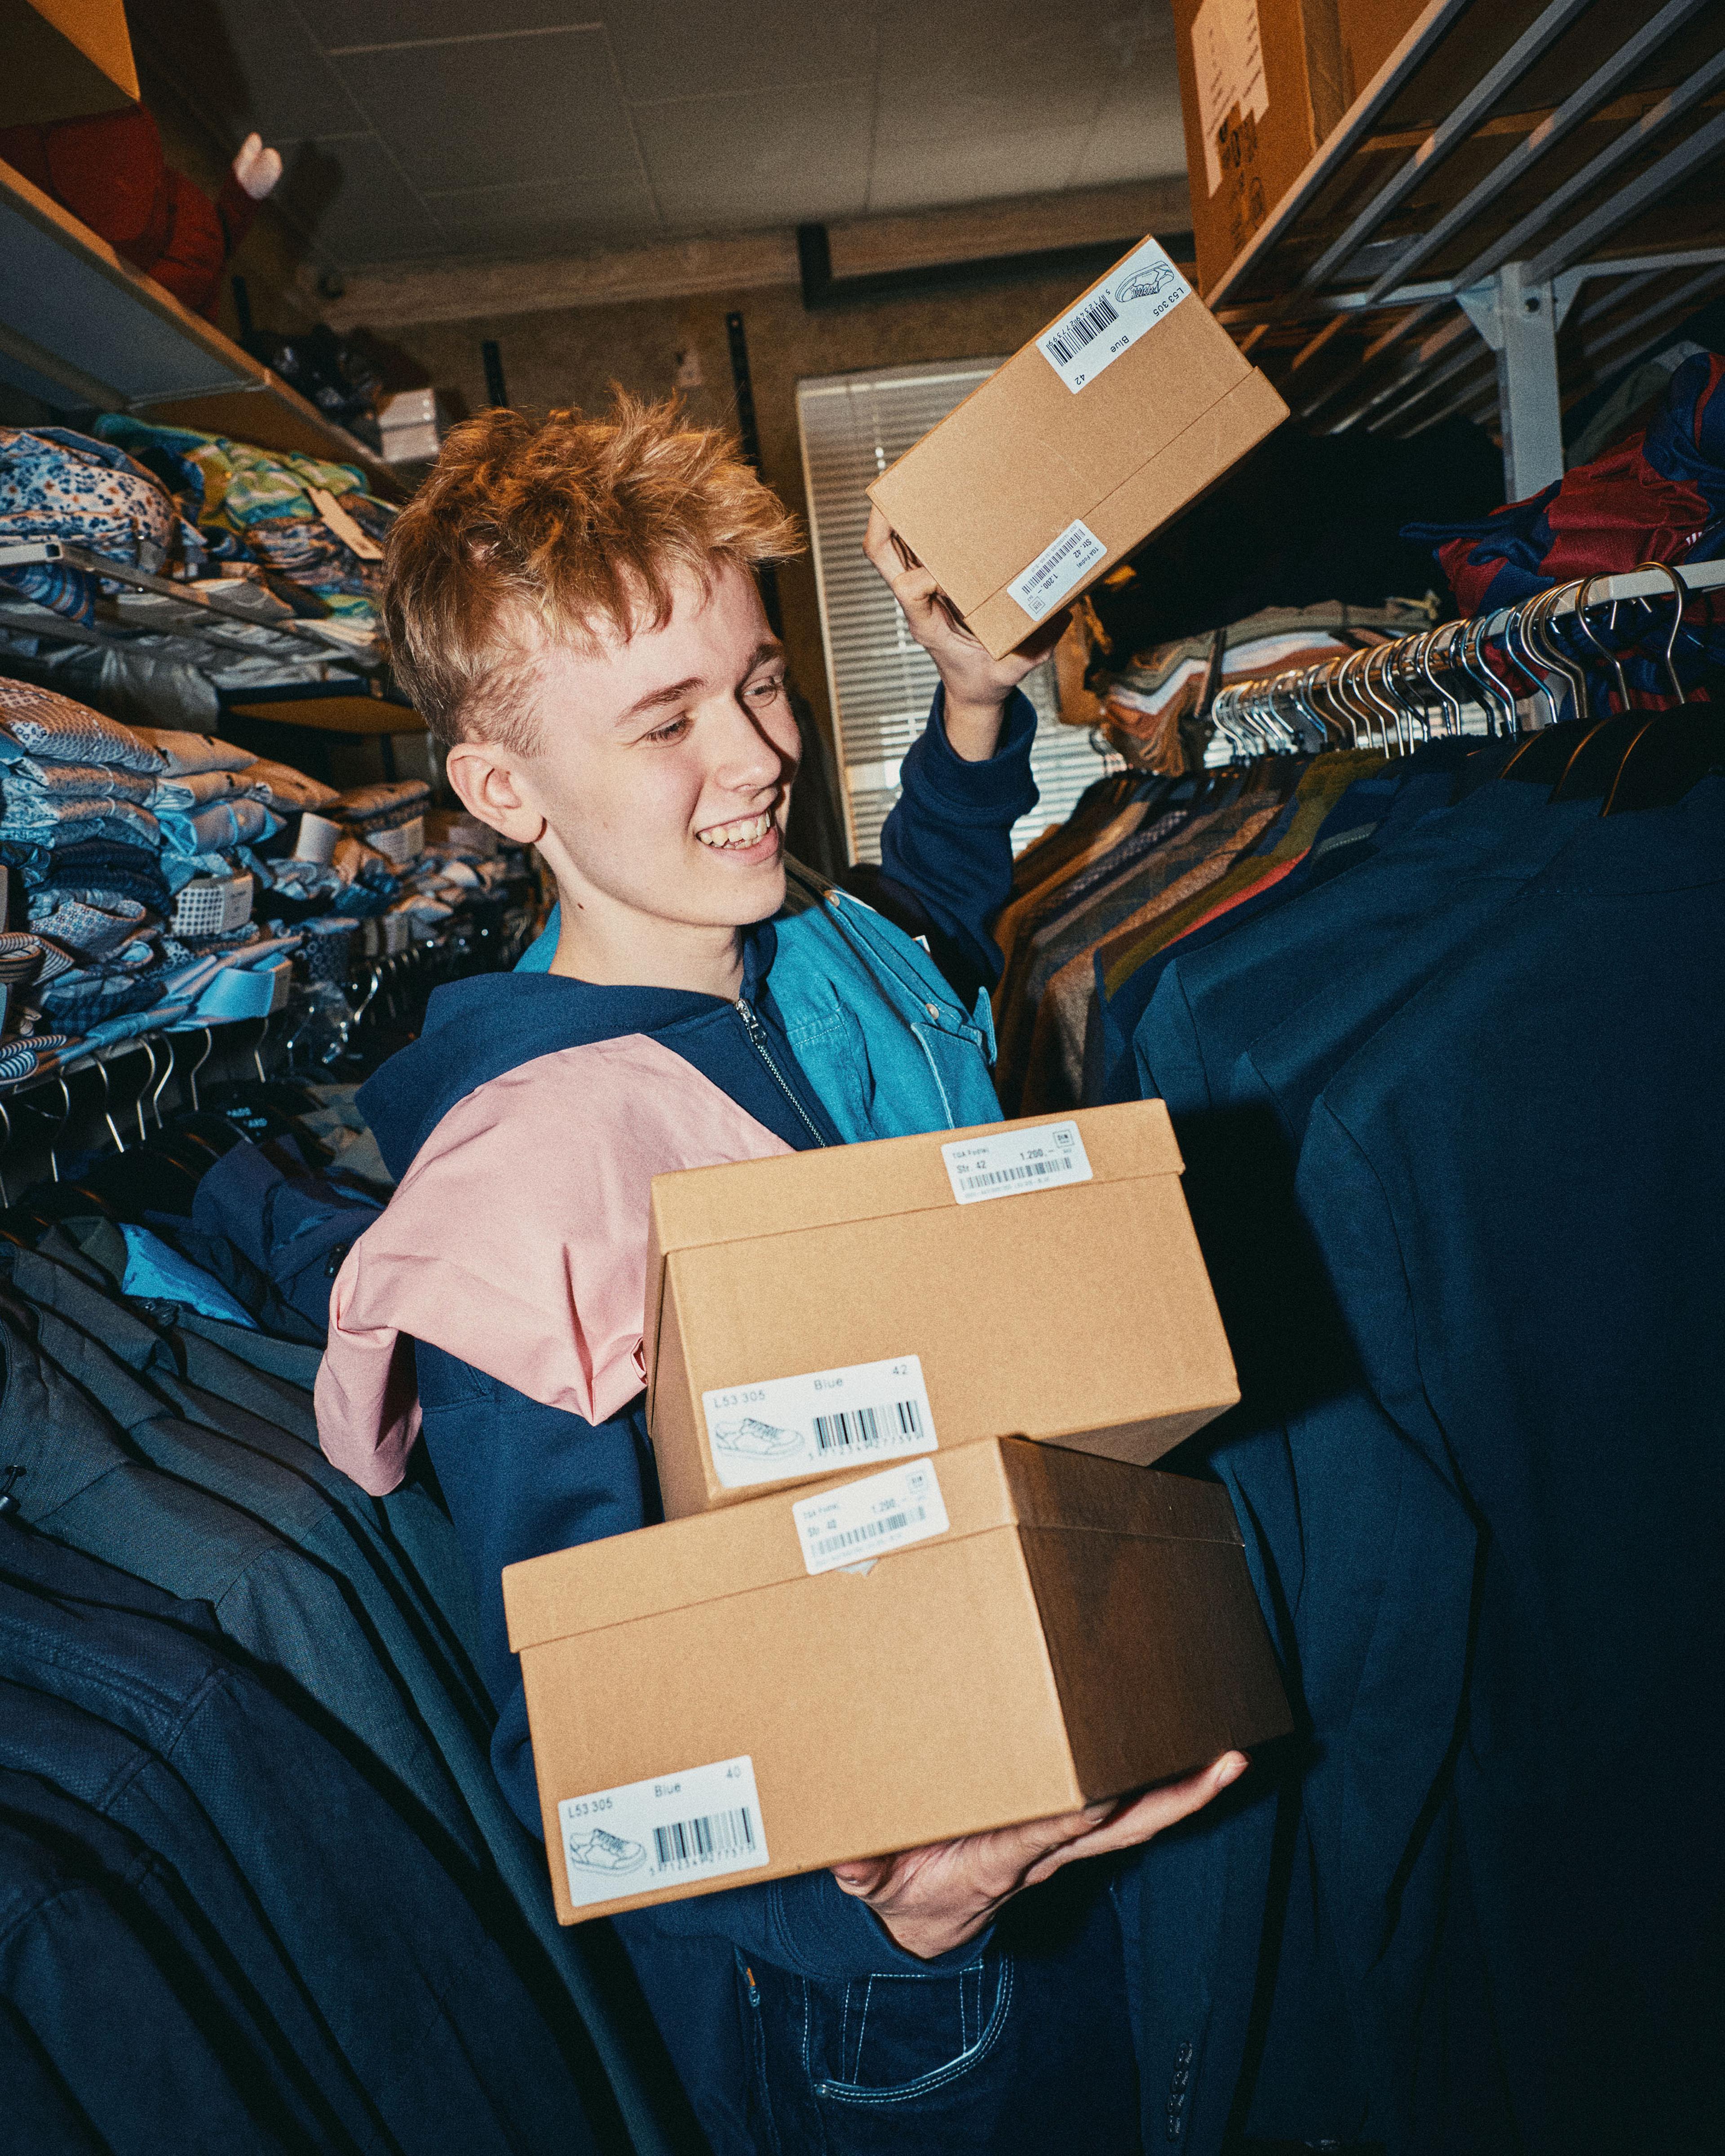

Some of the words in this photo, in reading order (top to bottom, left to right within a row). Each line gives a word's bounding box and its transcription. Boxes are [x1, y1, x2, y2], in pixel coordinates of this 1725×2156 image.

[1168, 287, 1185, 303] L53
[1076, 296, 1103, 322] 712349
[1153, 300, 1169, 316] 305
[1048, 320, 1076, 347] 277399
[1110, 335, 1130, 353] Blue
[1074, 374, 1085, 385] 42
[1080, 539, 1092, 548] Str.
[1073, 549, 1081, 558] 42
[1089, 547, 1099, 557] TGA
[976, 1160, 987, 1170] 42
[713, 1395, 738, 1409] L53
[742, 1389, 765, 1403] 305
[814, 1378, 843, 1391] Blue
[892, 1364, 907, 1376] 42
[568, 1803, 589, 1819] L53
[592, 1797, 613, 1812] 305
[654, 1783, 681, 1798] Blue
[726, 1766, 740, 1779] 40
